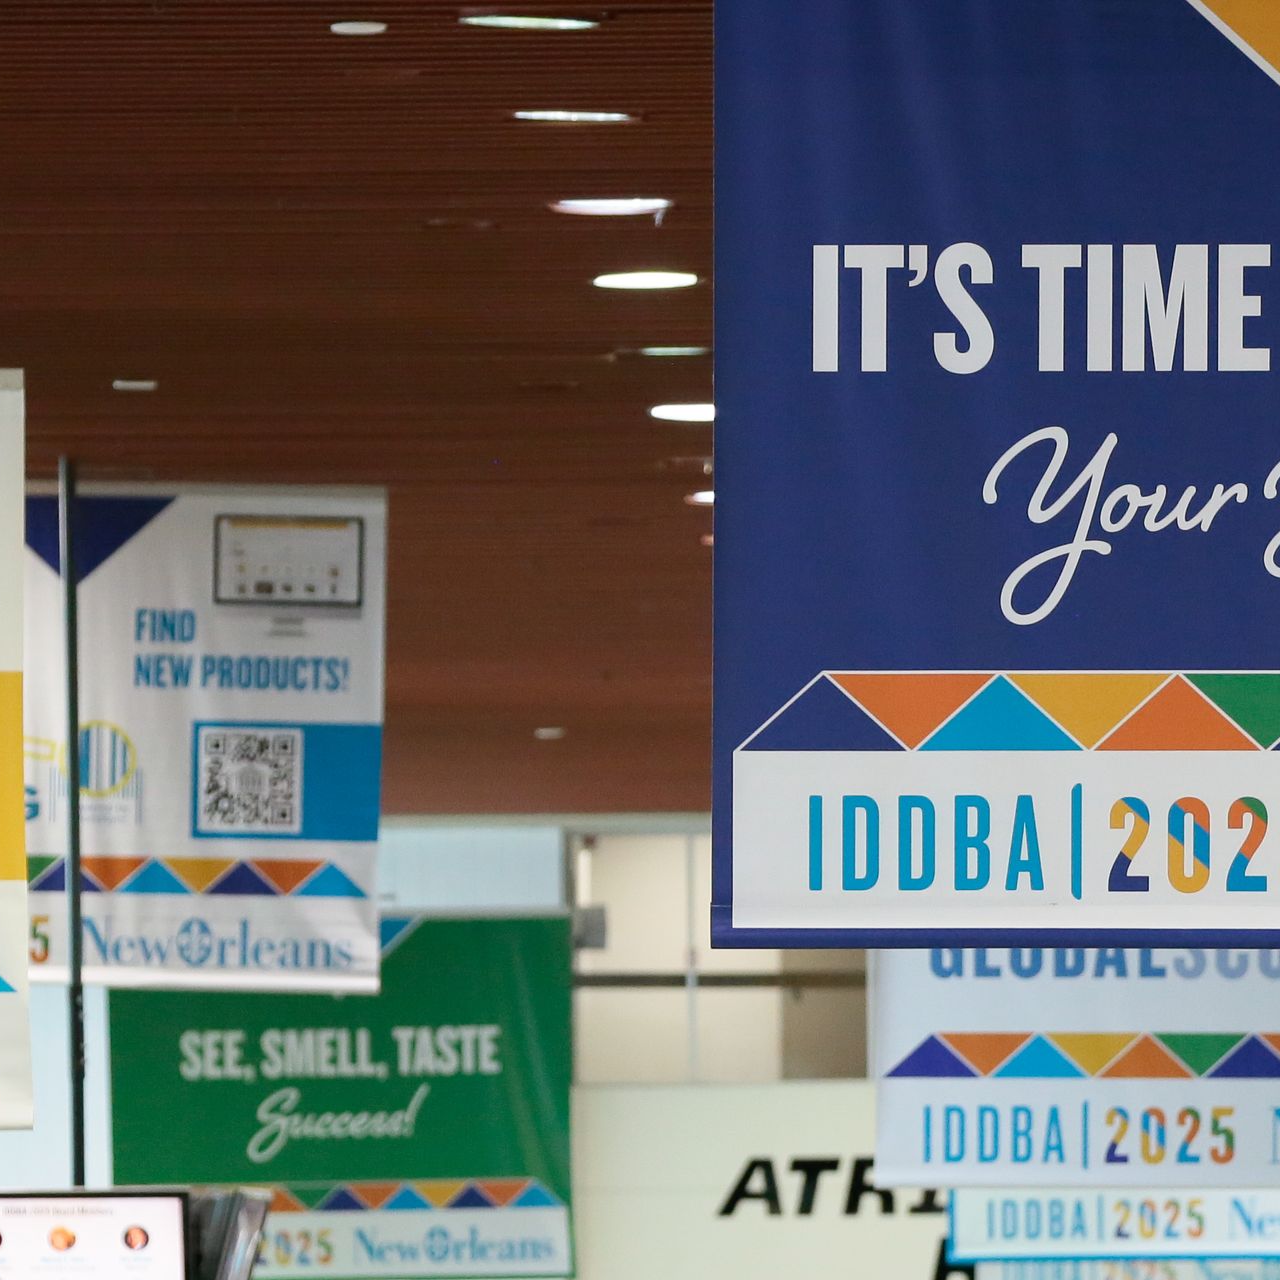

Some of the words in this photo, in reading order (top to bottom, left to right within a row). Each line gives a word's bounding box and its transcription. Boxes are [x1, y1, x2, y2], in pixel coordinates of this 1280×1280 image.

[811, 243, 995, 373] IT'S
[1022, 243, 1270, 372] TIME
[982, 425, 1246, 625] Your
[135, 609, 195, 642] FIND
[135, 655, 192, 688] NEW
[200, 655, 349, 690] PRODUCTS!
[809, 794, 1043, 892] IDDBA
[179, 1030, 256, 1083] SEE,
[261, 1028, 389, 1081] SMELL,
[393, 1025, 501, 1076] TASTE
[250, 1083, 429, 1162] Success!
[922, 1106, 1065, 1164] IDDBA
[1105, 1106, 1235, 1165] 2025
[986, 1200, 1090, 1240] IDDBA
[1114, 1199, 1205, 1240] 2025
